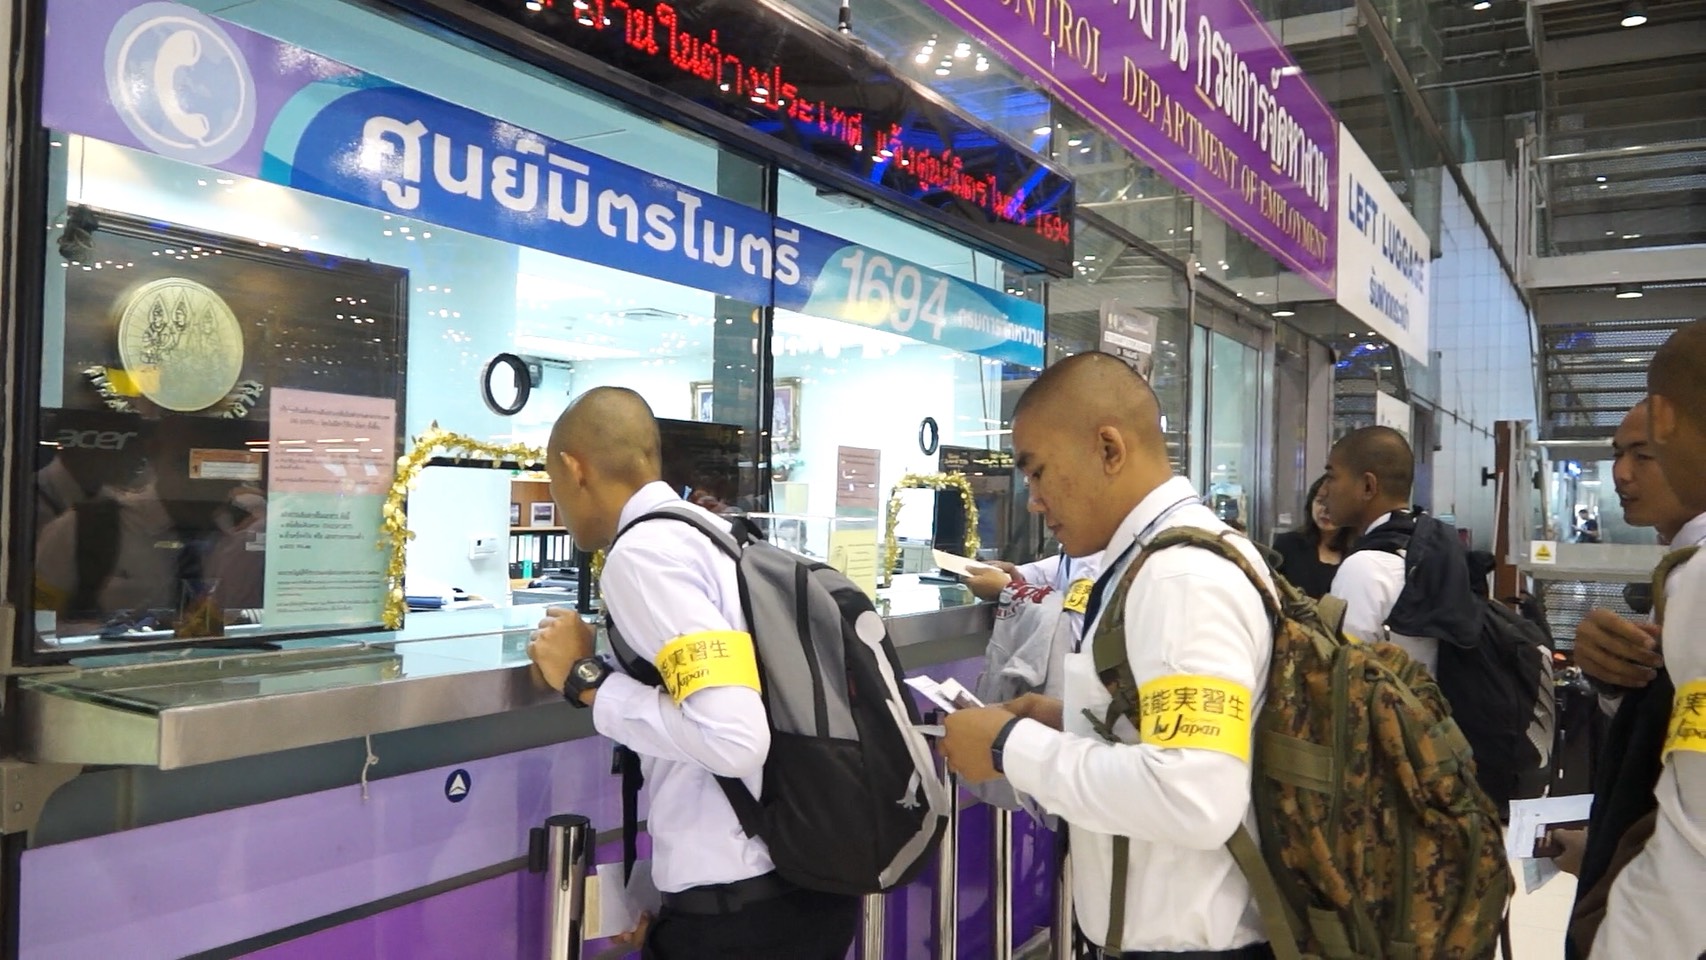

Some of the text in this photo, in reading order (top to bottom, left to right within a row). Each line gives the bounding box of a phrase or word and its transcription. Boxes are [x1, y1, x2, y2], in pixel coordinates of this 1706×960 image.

[1122, 56, 1239, 190] DEPARTMENT
[1241, 164, 1258, 205] OF
[1260, 180, 1329, 264] EMPLOYMENT
[362, 115, 801, 286] ศูนย์มิตรไมตรี
[842, 248, 950, 341] 1694
[1034, 209, 1070, 246] 1694
[1349, 173, 1424, 294] LEFT LUGGAGE
[57, 428, 138, 450] acer
[1157, 713, 1221, 742] Japan
